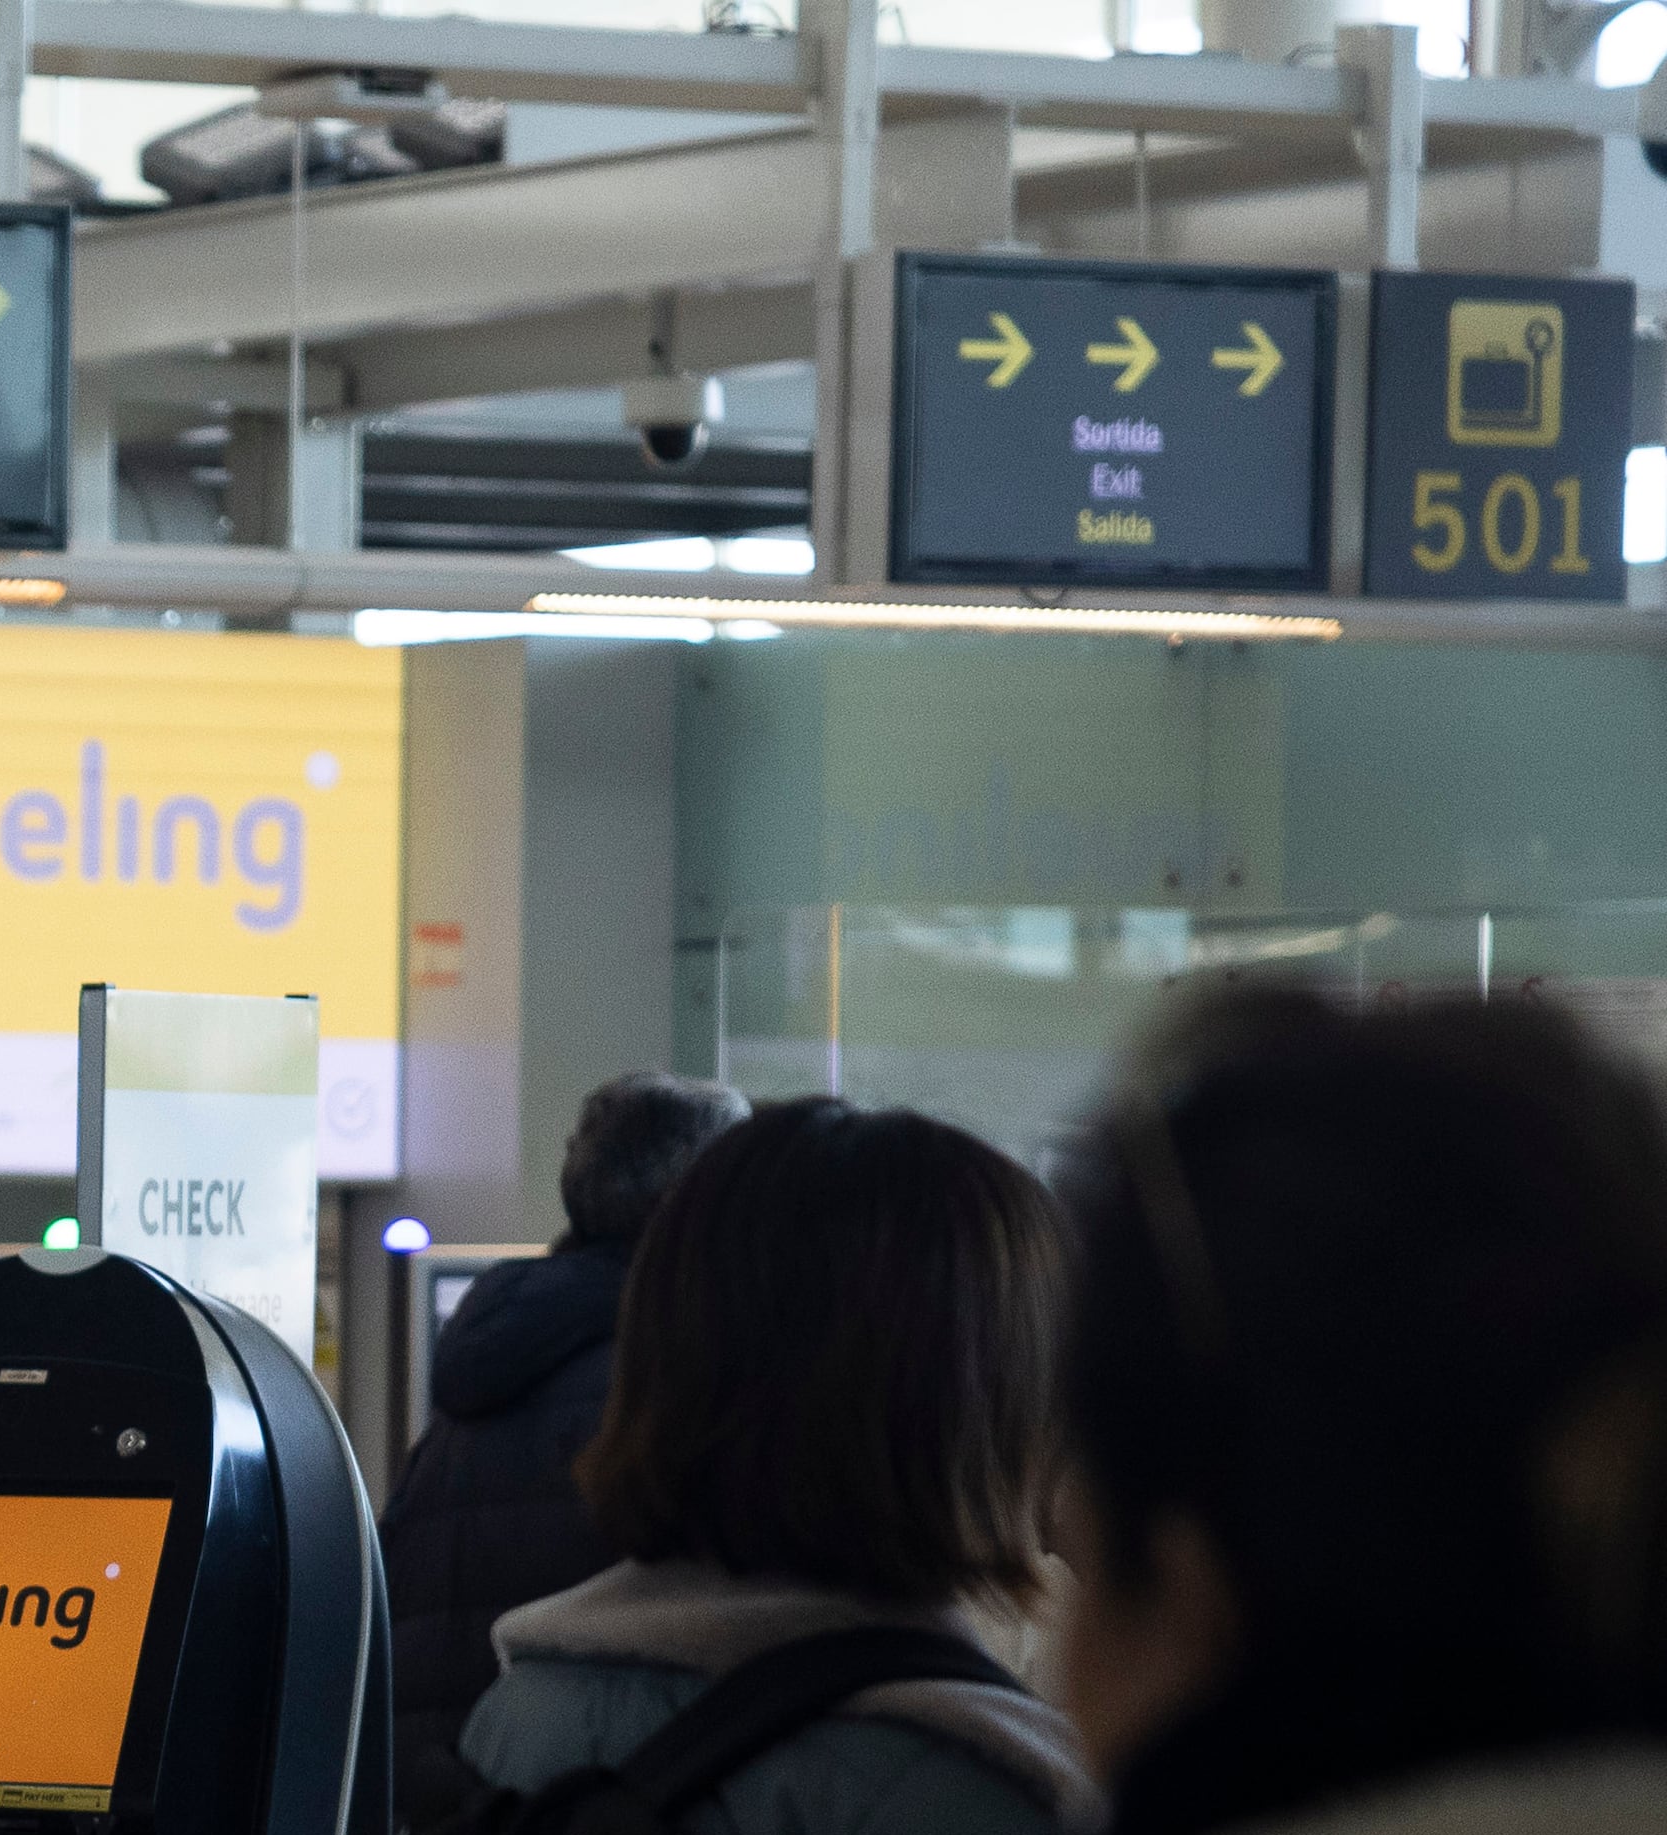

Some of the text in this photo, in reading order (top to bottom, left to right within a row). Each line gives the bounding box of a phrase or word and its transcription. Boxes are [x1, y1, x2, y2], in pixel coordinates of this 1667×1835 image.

[1072, 414, 1164, 452] Sortida
[1089, 462, 1143, 499] Exit
[1077, 510, 1154, 545] Salida
[1410, 469, 1591, 574] 501
[138, 1178, 246, 1236] CHECK
